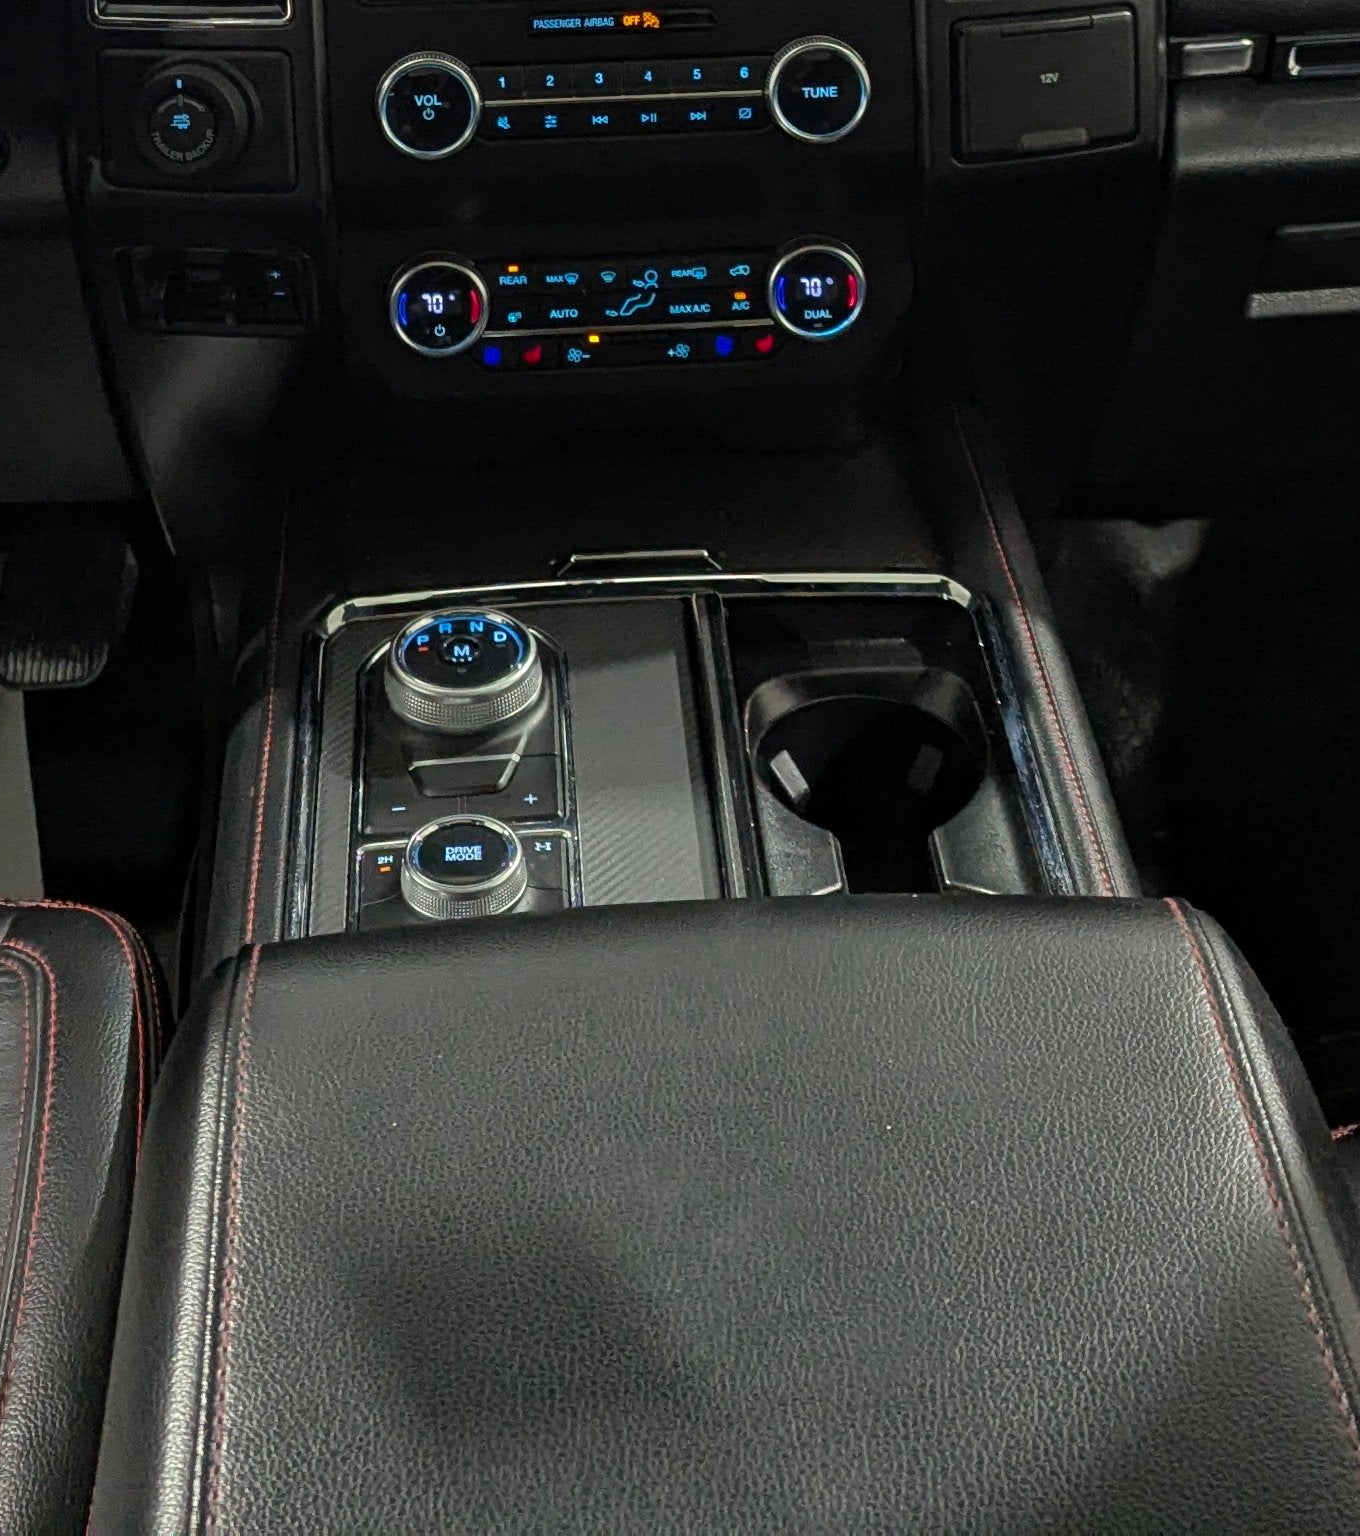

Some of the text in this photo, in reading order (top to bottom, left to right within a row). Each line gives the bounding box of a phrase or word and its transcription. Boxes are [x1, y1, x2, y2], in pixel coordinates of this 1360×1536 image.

[533, 15, 640, 29] PASSENGER AIRBAG OFF
[498, 67, 749, 88] 1 2 3 4 5 6
[1039, 73, 1060, 84] 12V
[801, 86, 839, 99] TUNE
[414, 94, 442, 106] VOL
[151, 128, 215, 162] TRAILER BACKUP
[546, 275, 563, 283] MAX
[671, 270, 693, 278] REAR
[499, 275, 528, 285] REAR
[669, 303, 711, 314] MAX A/C
[731, 301, 751, 311] A/C
[550, 309, 579, 319] AUTO
[804, 309, 833, 320] DUAL
[439, 623, 452, 634] R
[469, 621, 484, 633] N
[417, 635, 430, 645] P
[494, 631, 507, 643] D
[453, 645, 470, 656] M
[445, 845, 482, 854] DRIVE
[377, 855, 394, 864] 2H
[445, 853, 482, 861] MODE
